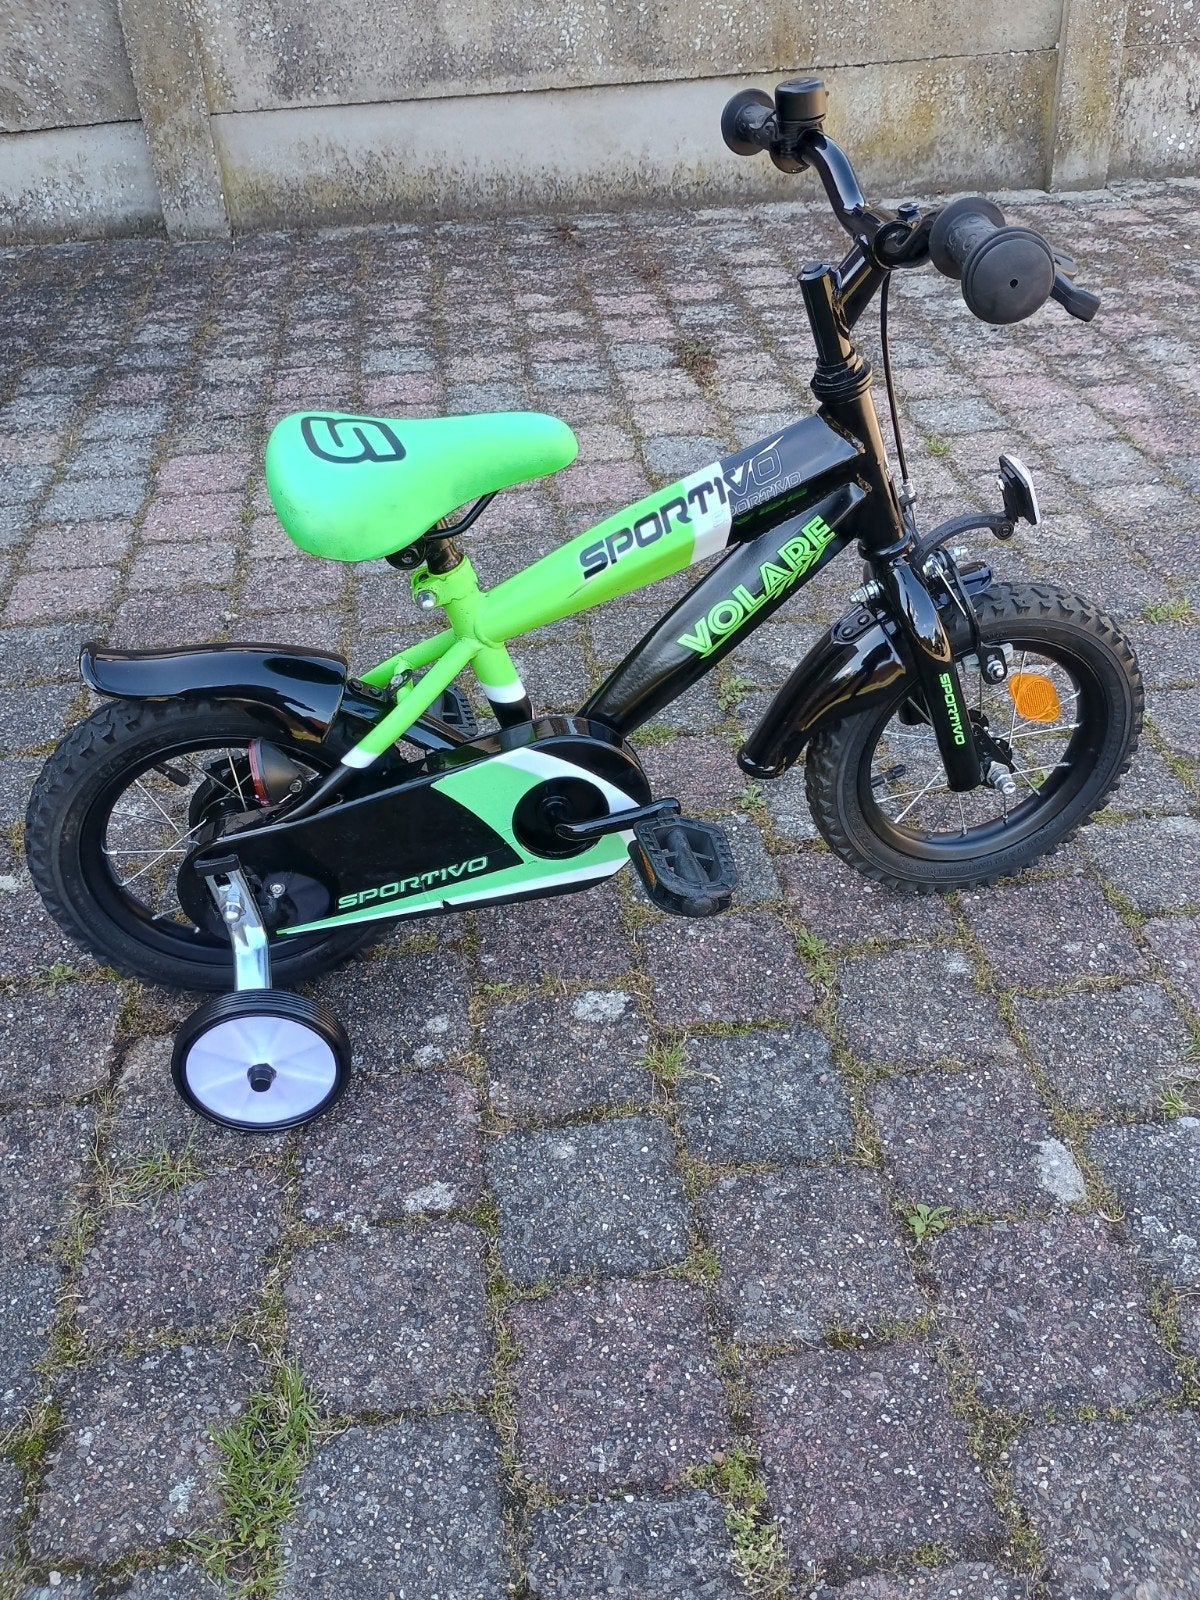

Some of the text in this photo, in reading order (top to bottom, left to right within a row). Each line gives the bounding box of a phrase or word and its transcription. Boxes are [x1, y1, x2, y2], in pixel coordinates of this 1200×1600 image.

[579, 448, 782, 579] SPORTIVO
[677, 514, 836, 658] VOLARE
[939, 672, 966, 746] SPORTIVO
[338, 855, 489, 909] SPORTIVO
